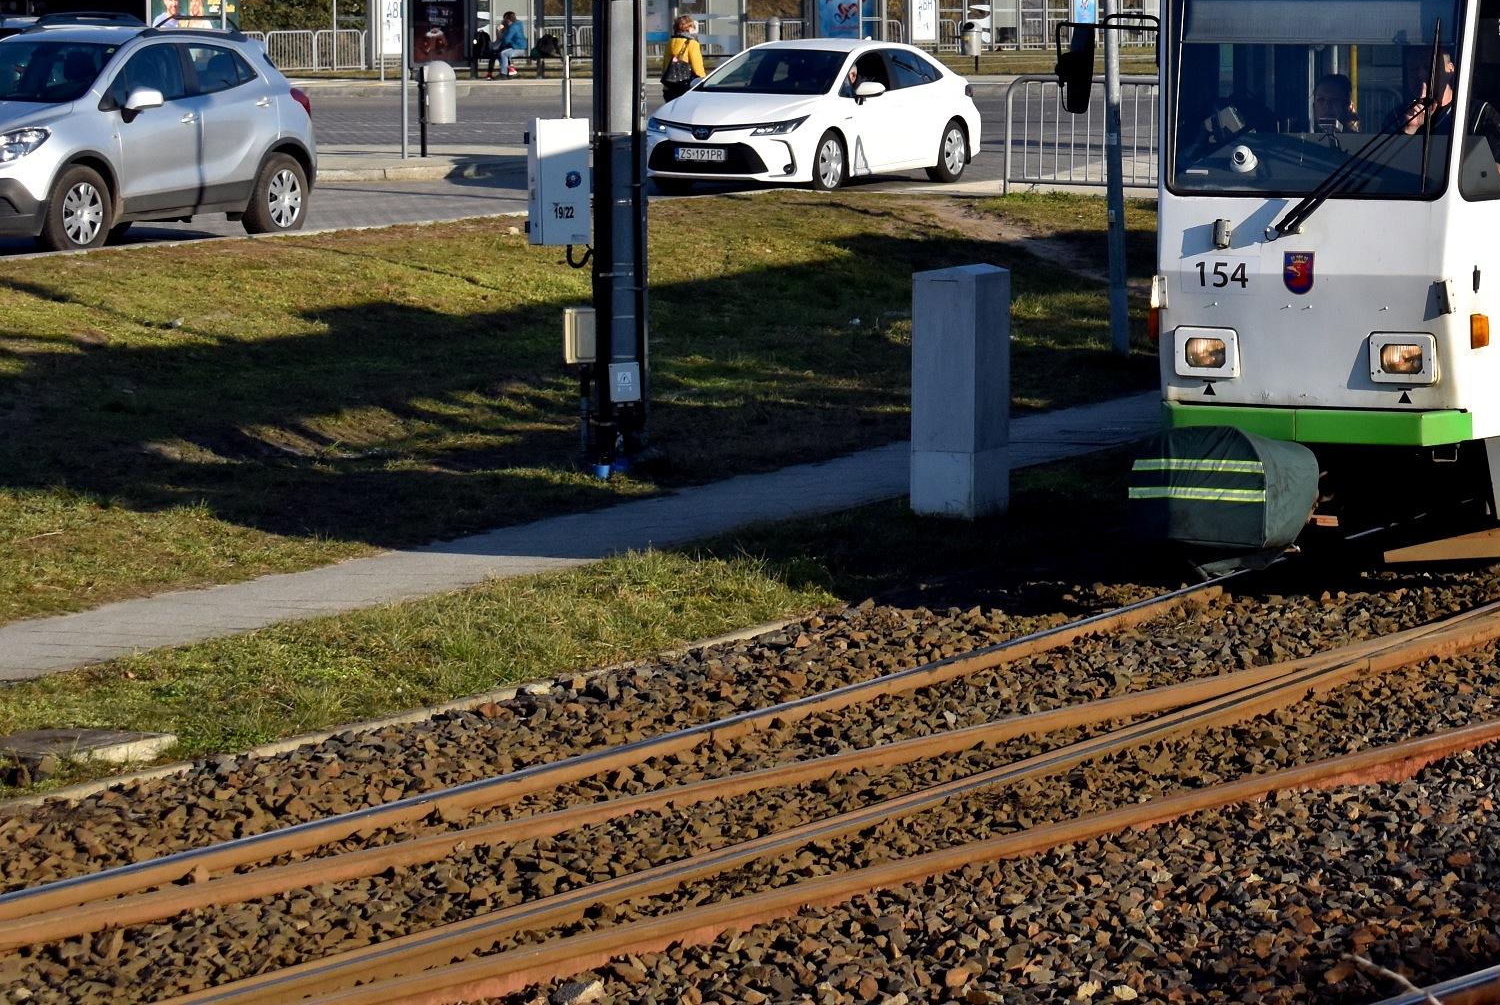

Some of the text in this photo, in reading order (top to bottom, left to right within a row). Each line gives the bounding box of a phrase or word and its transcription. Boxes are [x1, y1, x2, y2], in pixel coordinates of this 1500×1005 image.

[680, 148, 723, 160] ZS 191PR
[1195, 261, 1249, 289] 154
